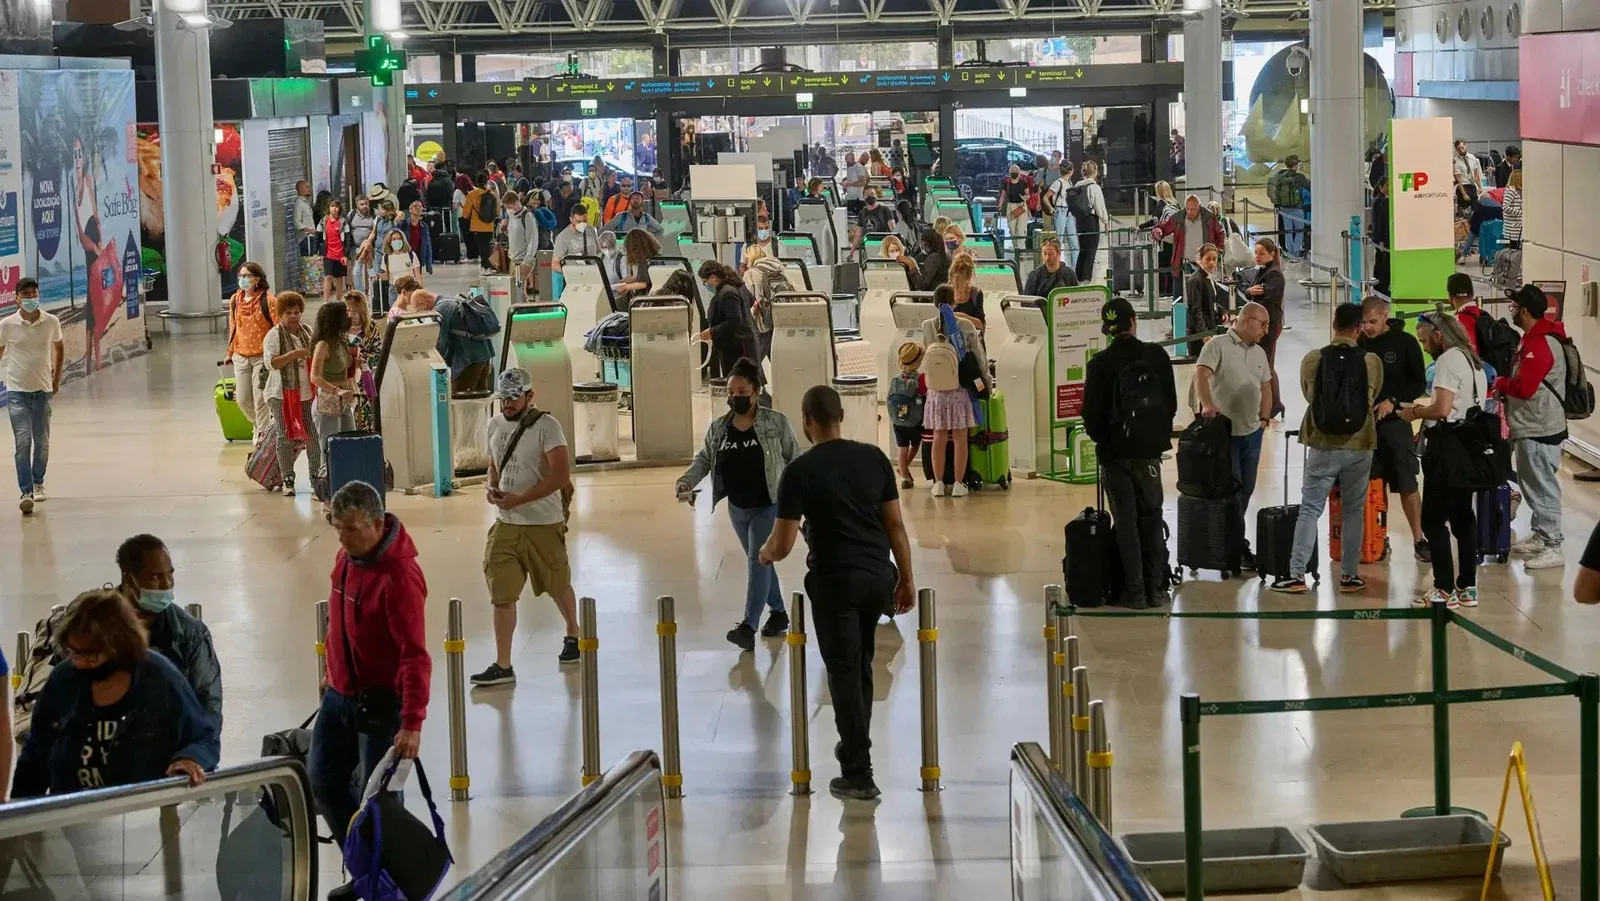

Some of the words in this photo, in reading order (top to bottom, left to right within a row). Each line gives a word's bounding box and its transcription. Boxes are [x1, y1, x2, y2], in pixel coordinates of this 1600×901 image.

[40, 180, 54, 194] NOVA
[1398, 172, 1428, 192] TAP
[42, 210, 54, 224] AQUI
[743, 439, 758, 447] VA
